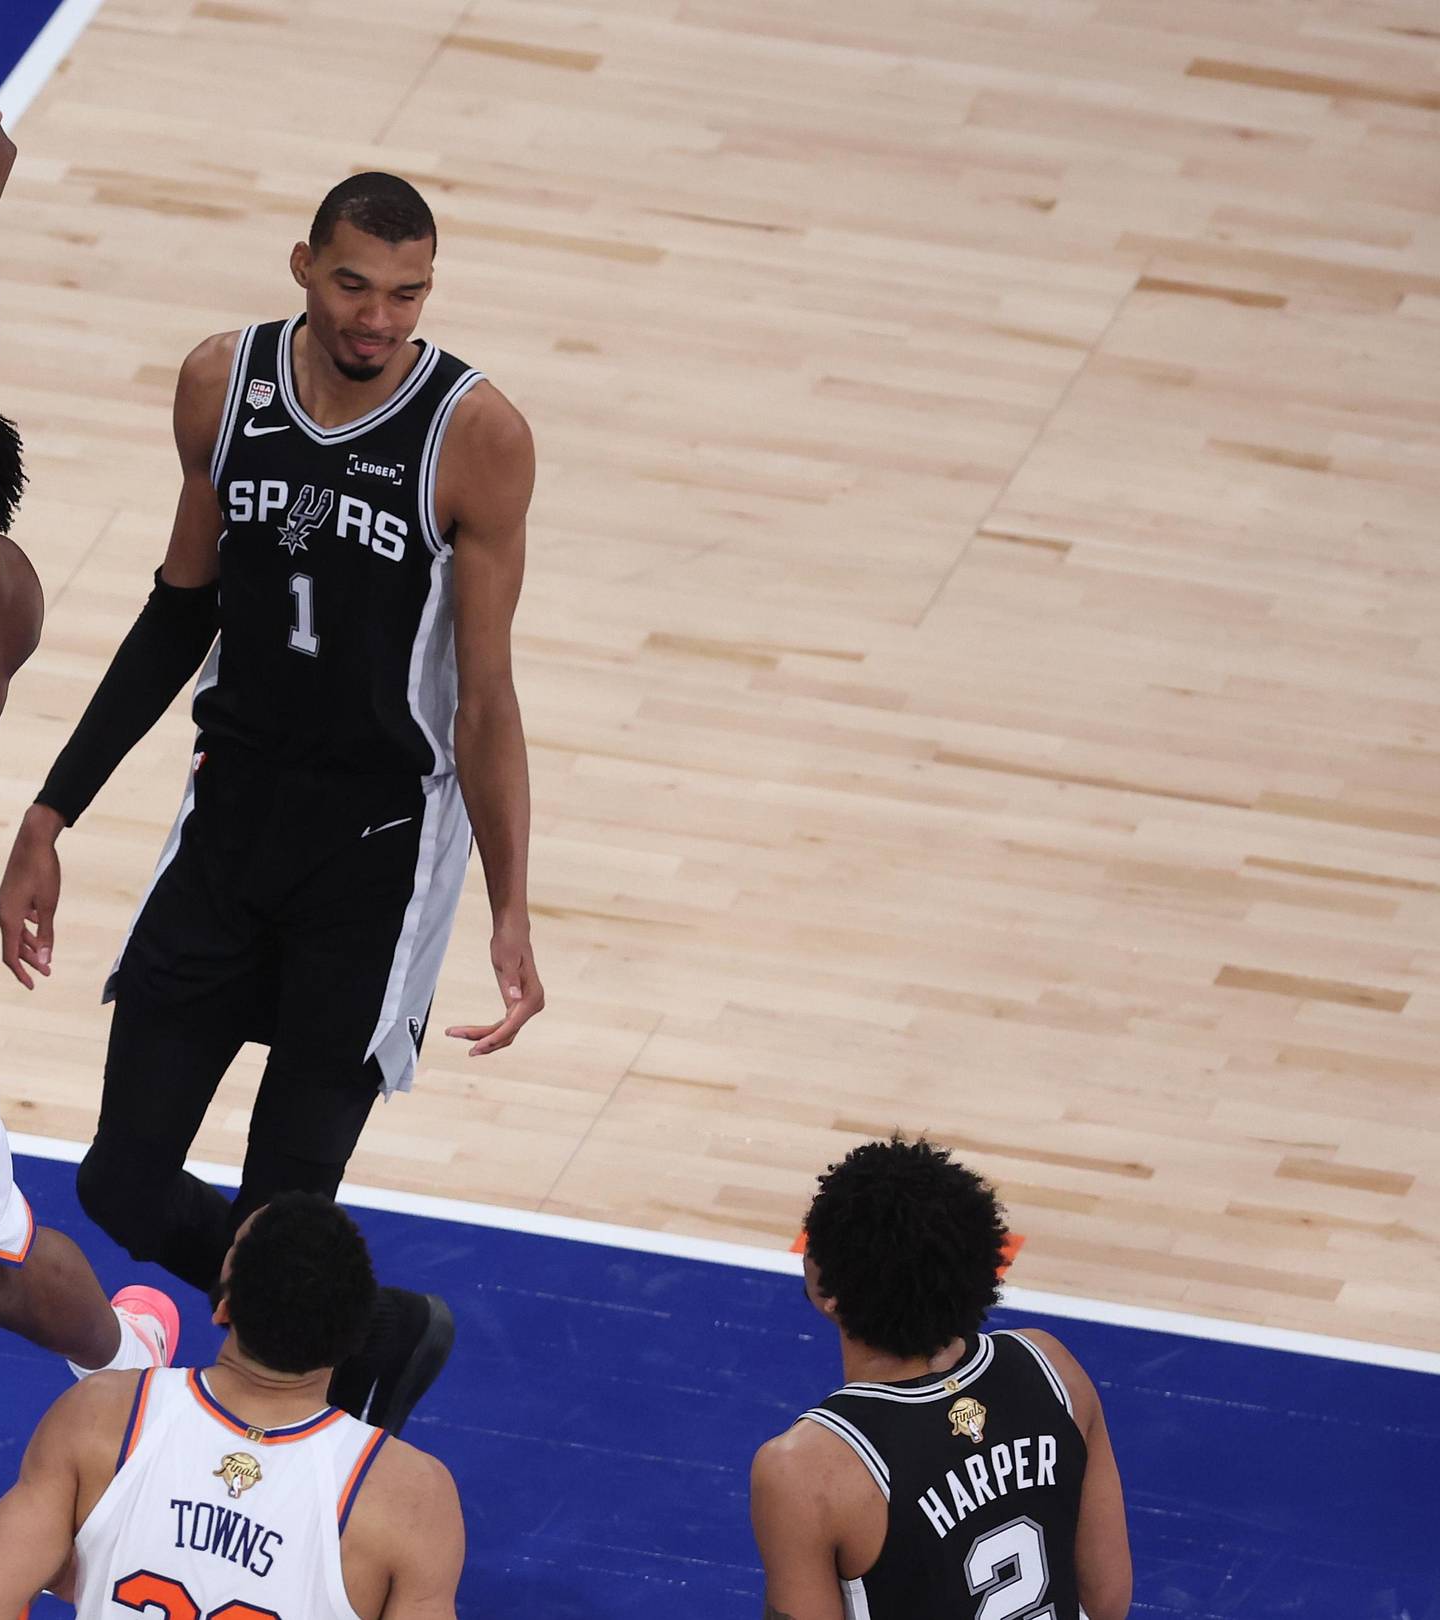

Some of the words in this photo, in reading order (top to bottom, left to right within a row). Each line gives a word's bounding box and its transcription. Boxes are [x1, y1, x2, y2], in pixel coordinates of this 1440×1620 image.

[253, 383, 271, 393] USA
[355, 460, 396, 478] LEDGER
[228, 479, 409, 562] SPURS
[287, 572, 320, 657] 1
[951, 1402, 984, 1431] Finals
[212, 1454, 263, 1479] Finals
[917, 1434, 1057, 1539] HARPER
[170, 1499, 283, 1578] TOWNS
[963, 1515, 1056, 1620] 2
